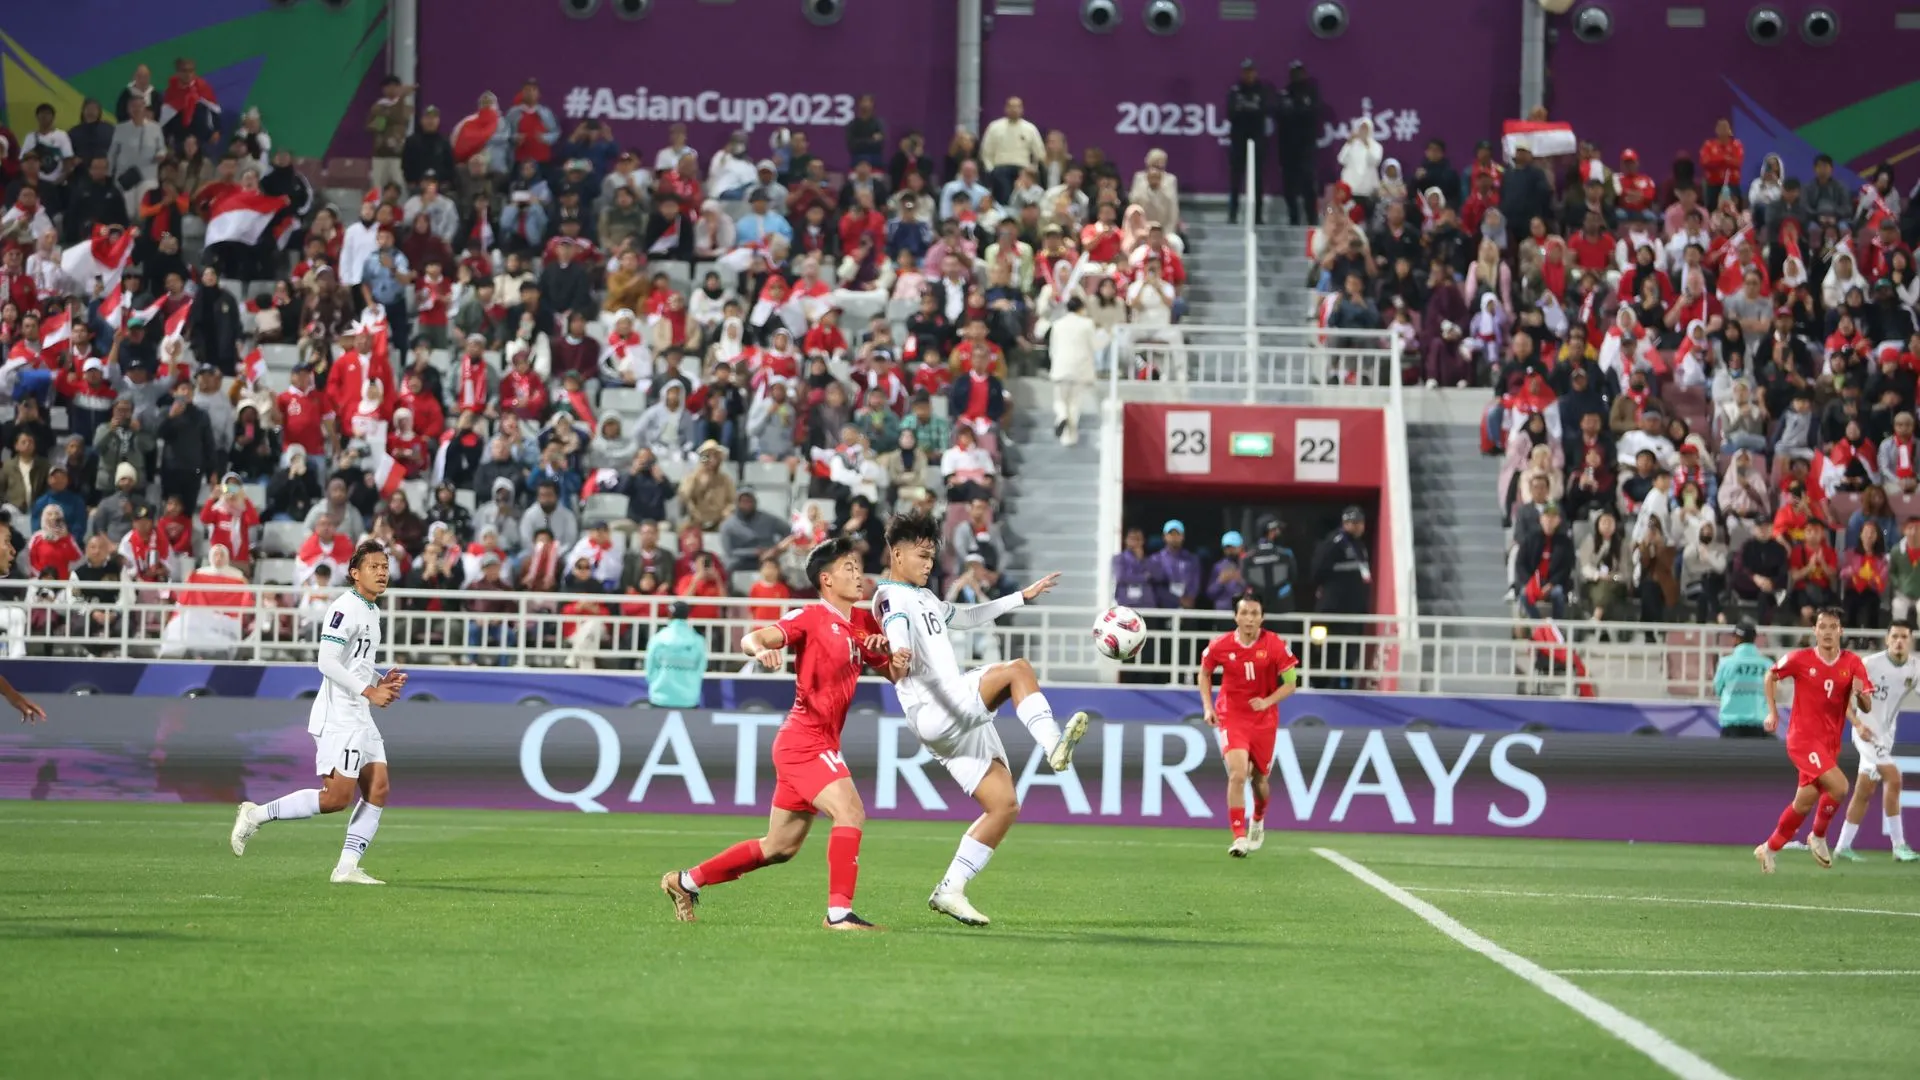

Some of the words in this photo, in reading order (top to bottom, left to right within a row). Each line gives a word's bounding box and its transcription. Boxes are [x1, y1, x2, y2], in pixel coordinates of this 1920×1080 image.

[564, 87, 856, 132] #AsianCup2023
[1171, 430, 1207, 455] 23
[1300, 438, 1336, 463] 22
[921, 612, 942, 636] 16
[354, 638, 371, 658] 17
[1243, 661, 1255, 681] 11
[1824, 679, 1834, 699] 9
[344, 749, 360, 771] 17
[520, 707, 949, 813] QATR
[819, 750, 850, 772] 14
[1809, 752, 1822, 769] 9
